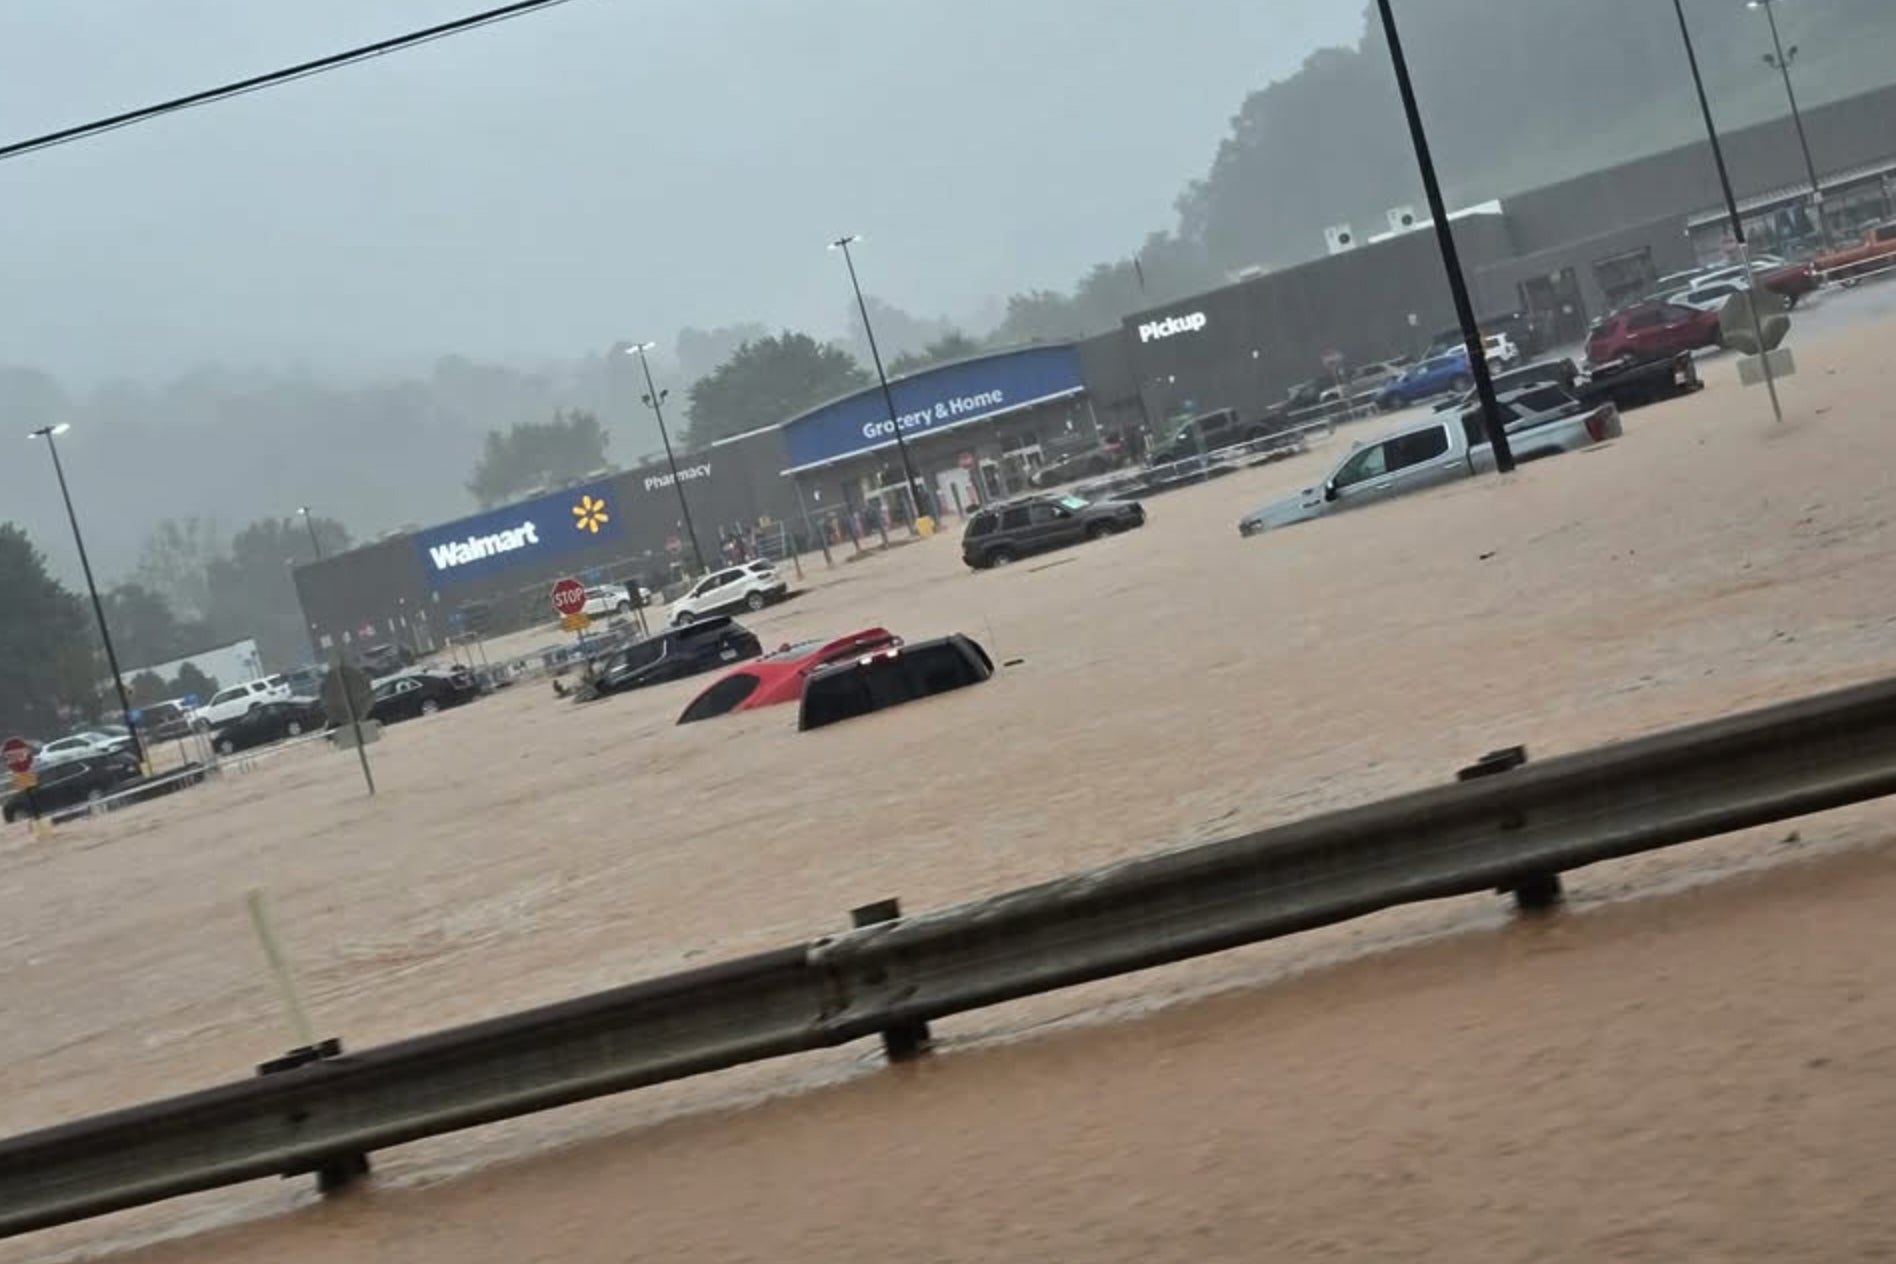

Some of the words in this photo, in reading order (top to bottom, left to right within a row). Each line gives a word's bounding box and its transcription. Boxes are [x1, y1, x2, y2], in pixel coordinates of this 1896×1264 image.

[1138, 312, 1207, 343] Pickup
[862, 408, 932, 438] Grocery
[934, 402, 949, 419] &
[949, 389, 1003, 415] Home
[644, 462, 711, 491] Pharmacy
[429, 521, 539, 571] Walmart
[555, 587, 583, 607] STOP
